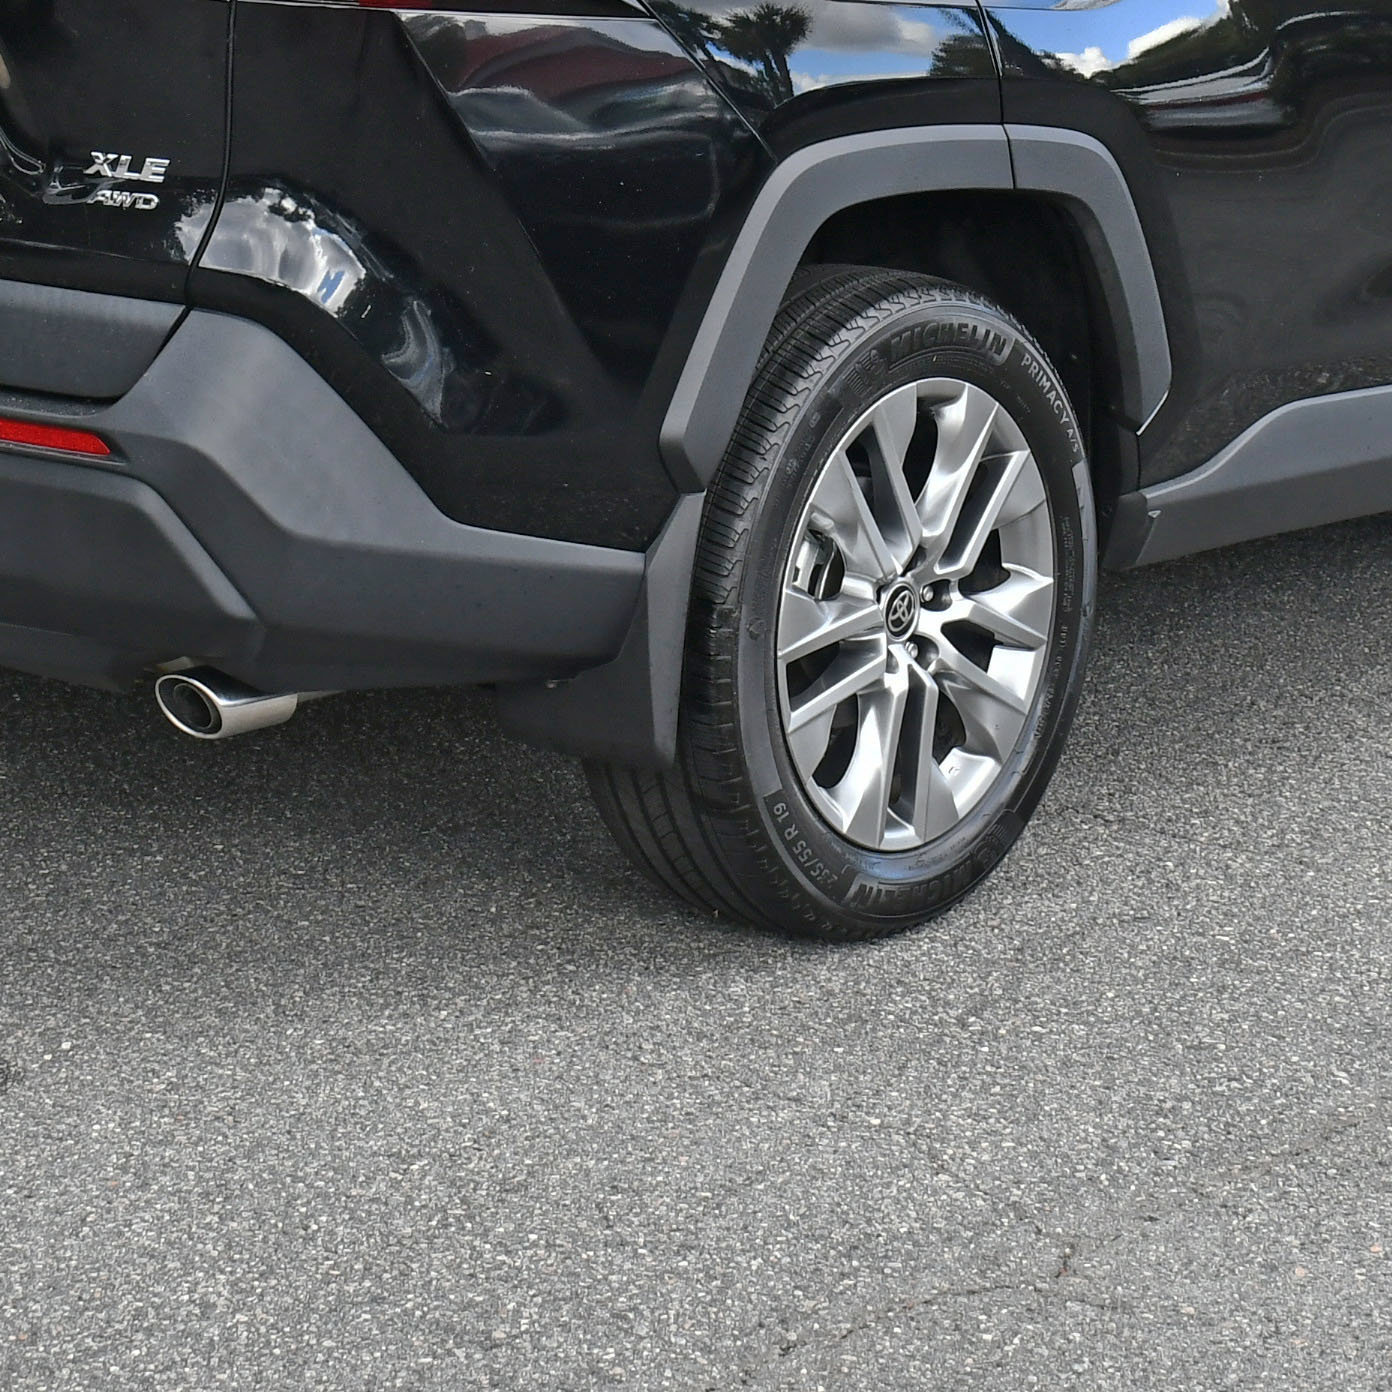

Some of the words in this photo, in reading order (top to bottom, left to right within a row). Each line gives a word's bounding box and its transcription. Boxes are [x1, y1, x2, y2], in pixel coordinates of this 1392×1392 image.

[83, 151, 170, 183] XLE
[87, 190, 160, 210] AWD
[889, 321, 1008, 357] MICHELIN
[1021, 353, 1069, 425] PRIMACY
[773, 802, 791, 824] 19
[784, 824, 799, 839] R
